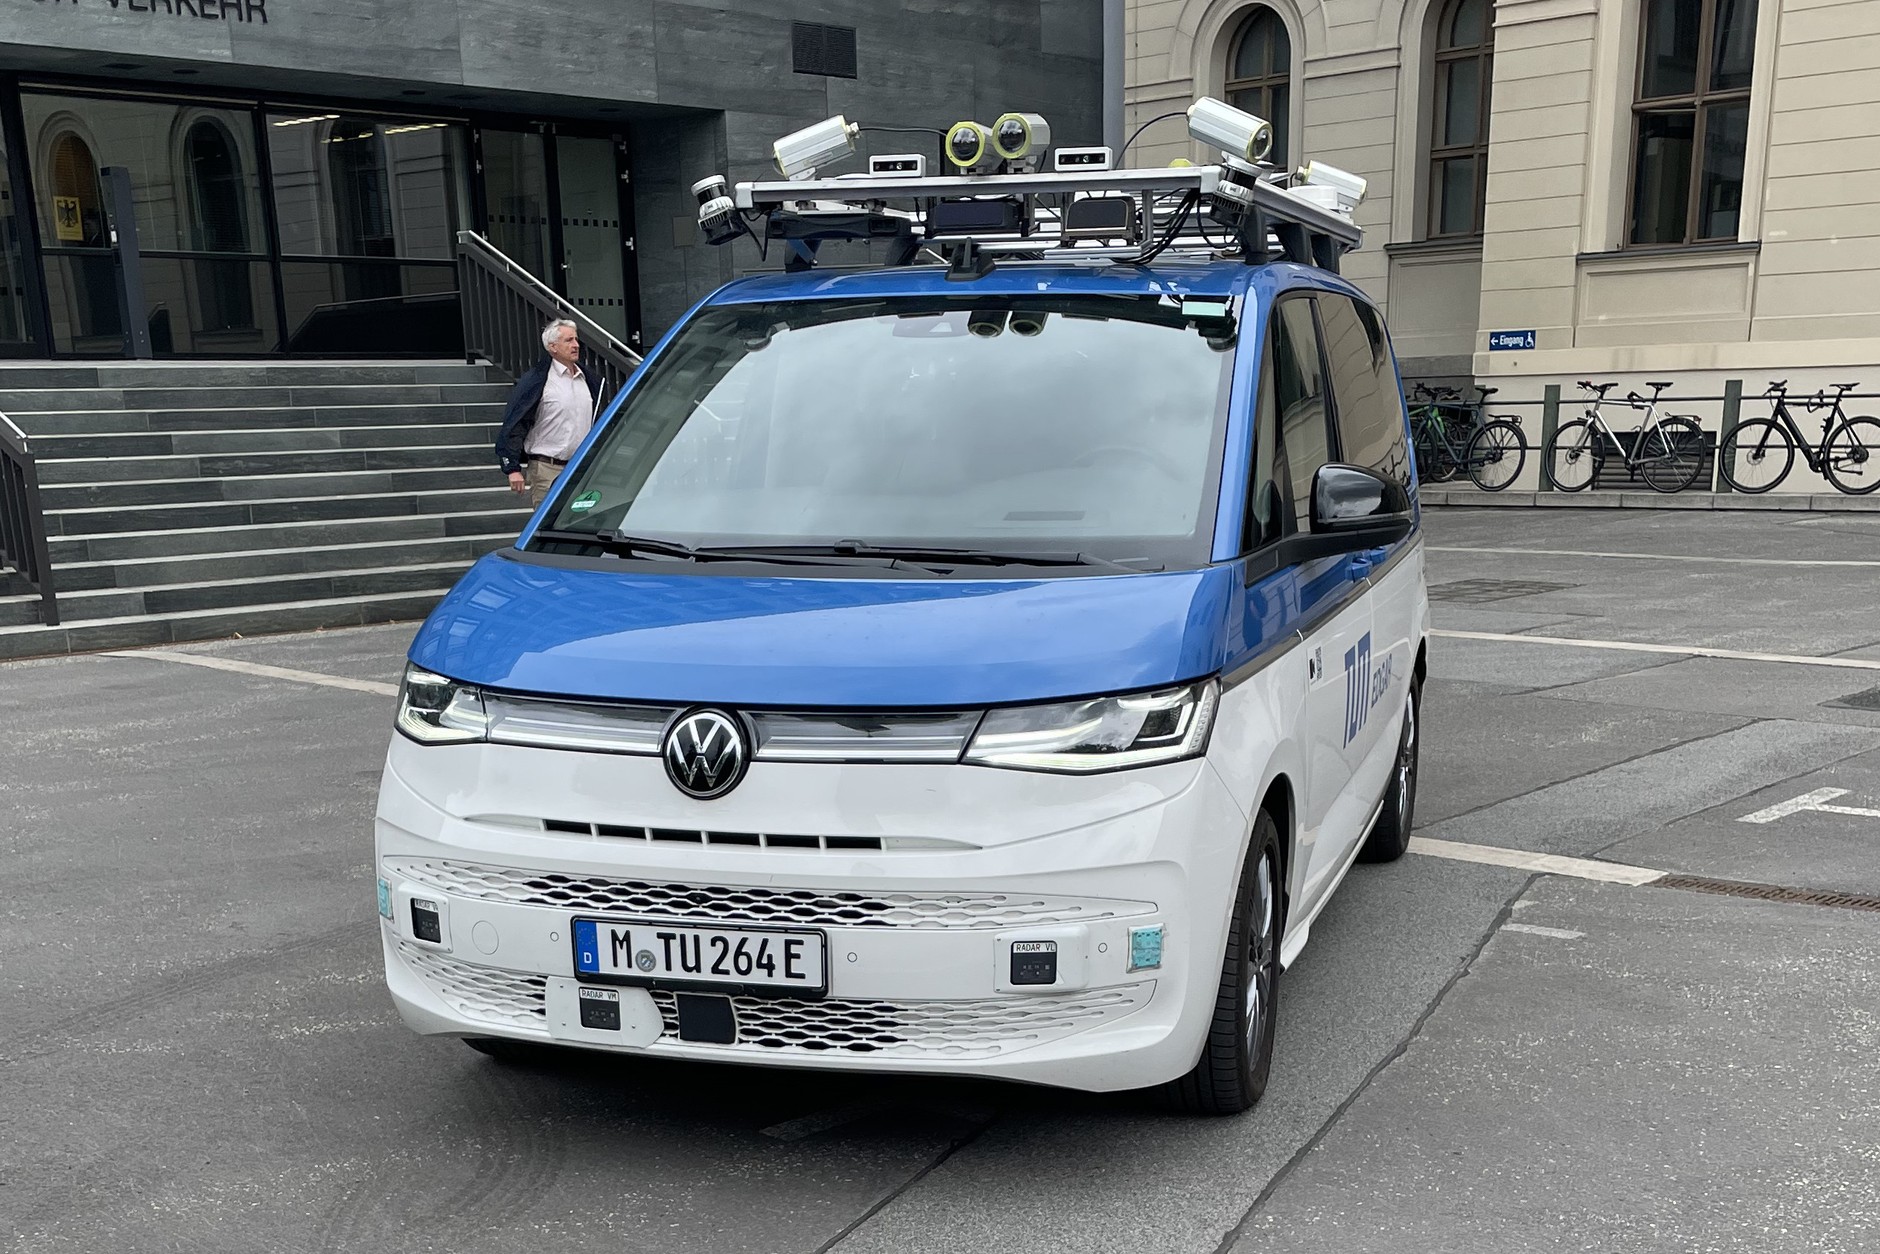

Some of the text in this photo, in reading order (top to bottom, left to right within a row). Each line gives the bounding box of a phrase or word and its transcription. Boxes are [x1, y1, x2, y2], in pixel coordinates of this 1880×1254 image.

[109, 0, 268, 23] KEHR
[1500, 334, 1524, 347] Eingang
[610, 929, 633, 969] M
[1016, 943, 1055, 952] RADAR VL
[584, 952, 592, 964] D
[582, 990, 616, 1000] RADAR VM
